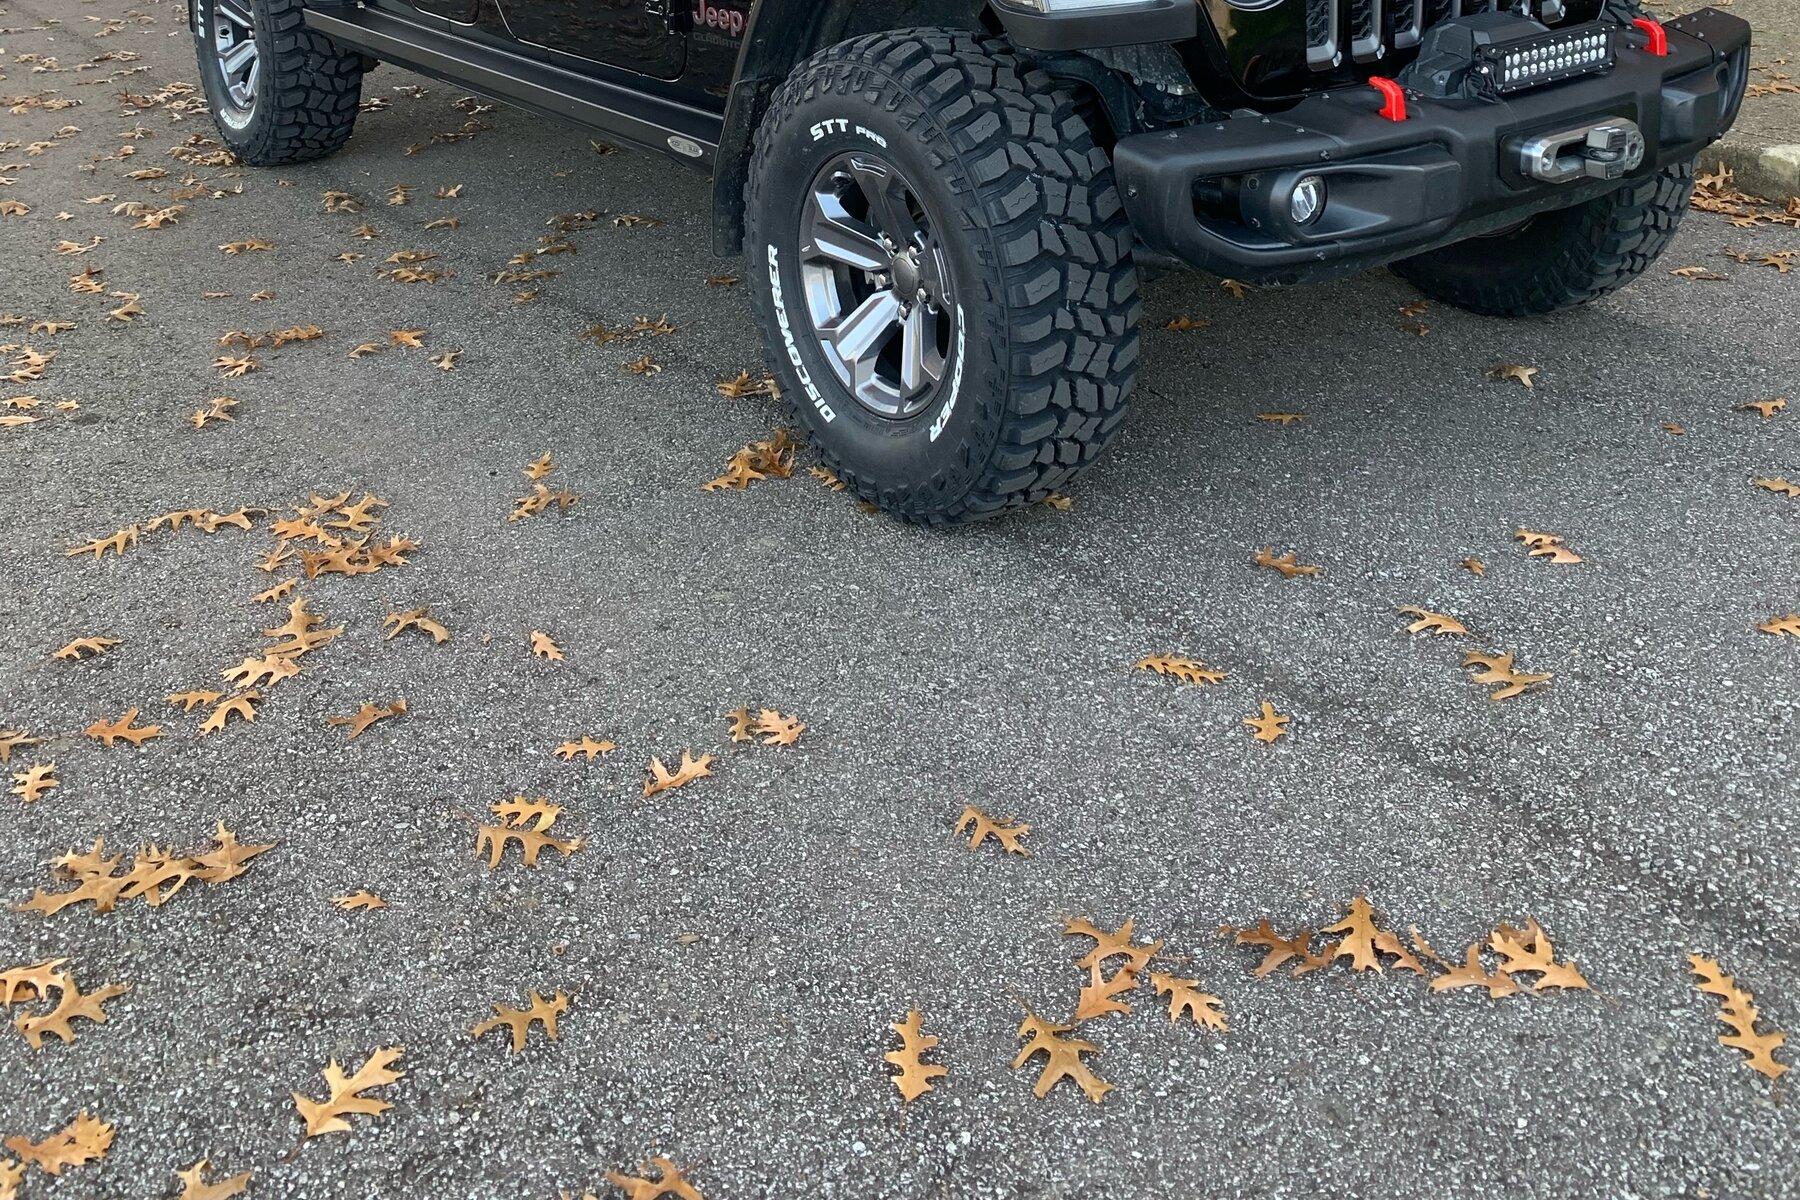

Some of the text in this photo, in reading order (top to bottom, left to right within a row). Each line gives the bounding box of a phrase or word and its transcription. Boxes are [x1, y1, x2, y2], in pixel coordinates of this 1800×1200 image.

[693, 32, 741, 48] GLADIATO
[810, 118, 887, 148] STT PRO
[768, 244, 837, 423] DISCOVERER
